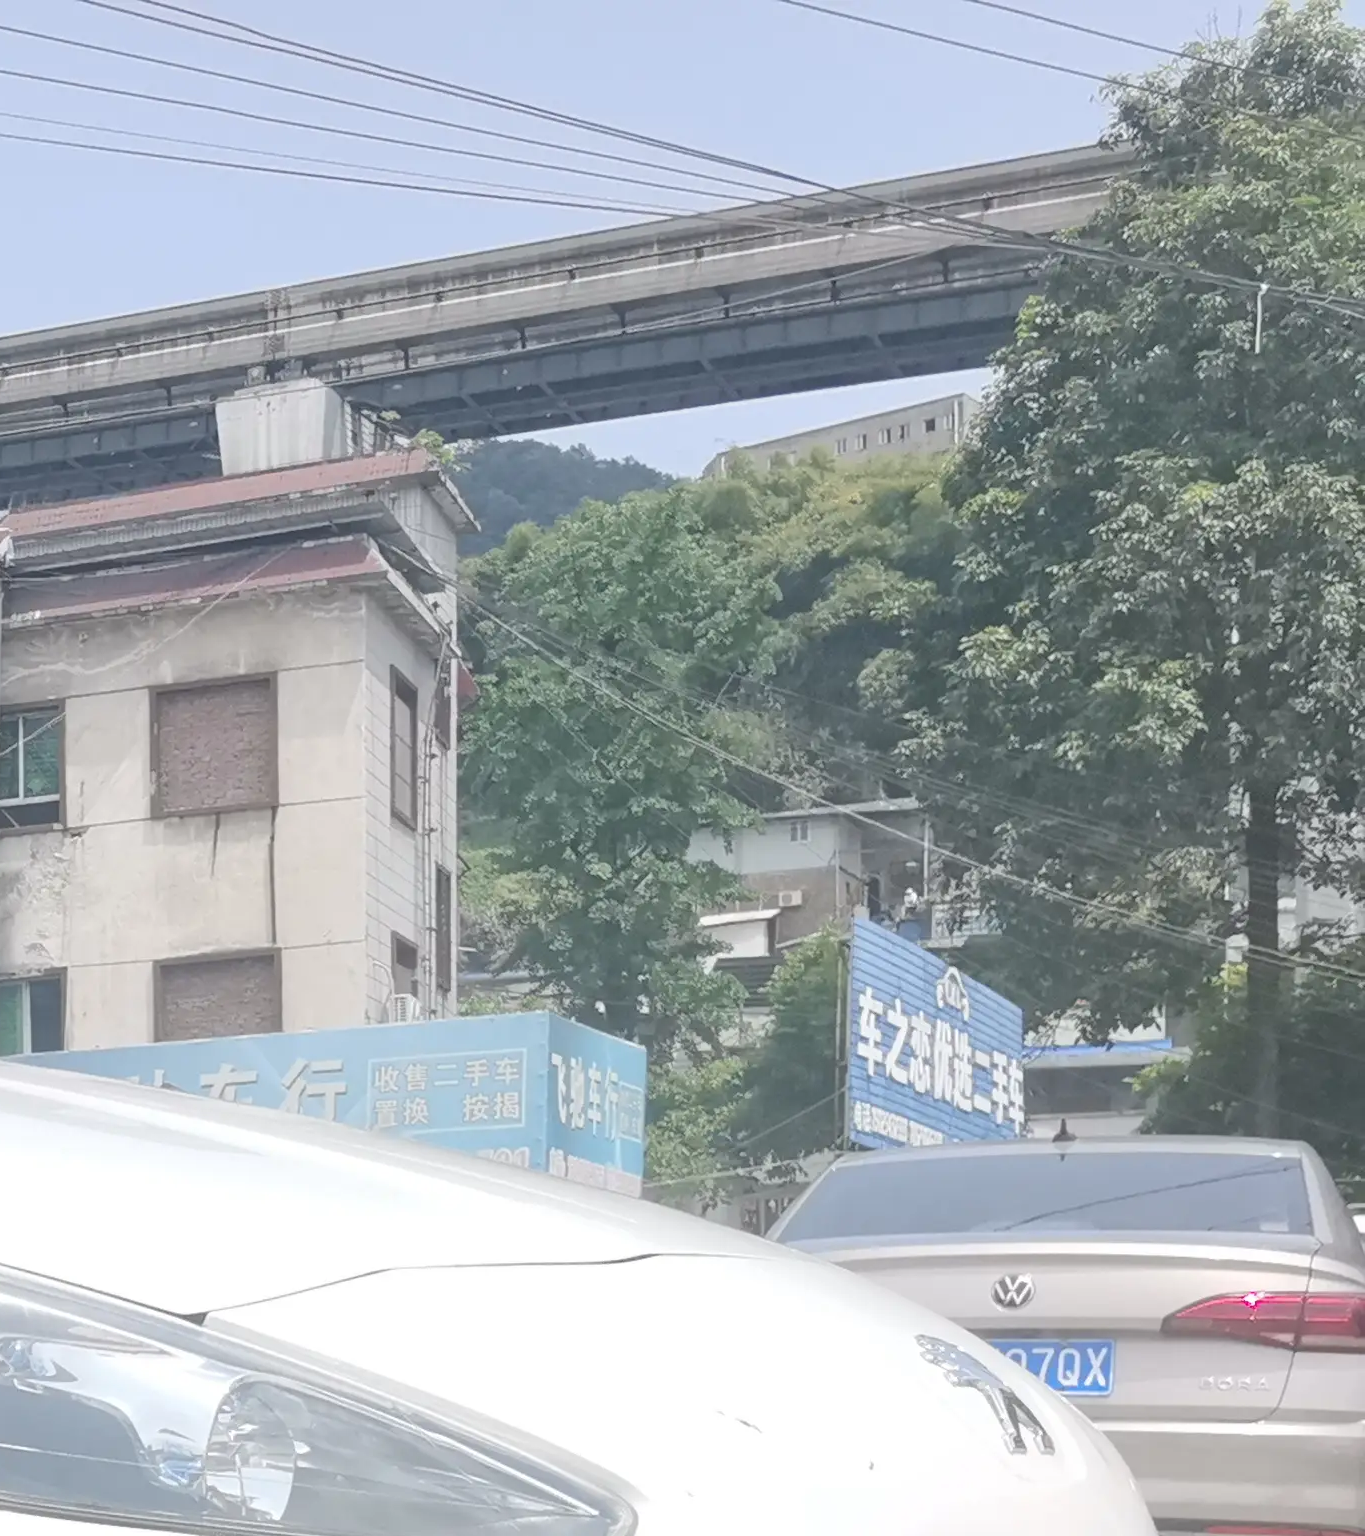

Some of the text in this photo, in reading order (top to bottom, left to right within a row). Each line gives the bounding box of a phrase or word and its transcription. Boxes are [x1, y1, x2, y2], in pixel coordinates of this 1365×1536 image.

[374, 1057, 520, 1093] 收售二手车
[857, 986, 1025, 1135] 车之恋优选二手车
[462, 1092, 520, 1122] 按揭
[551, 1053, 619, 1142] 飞驰车行
